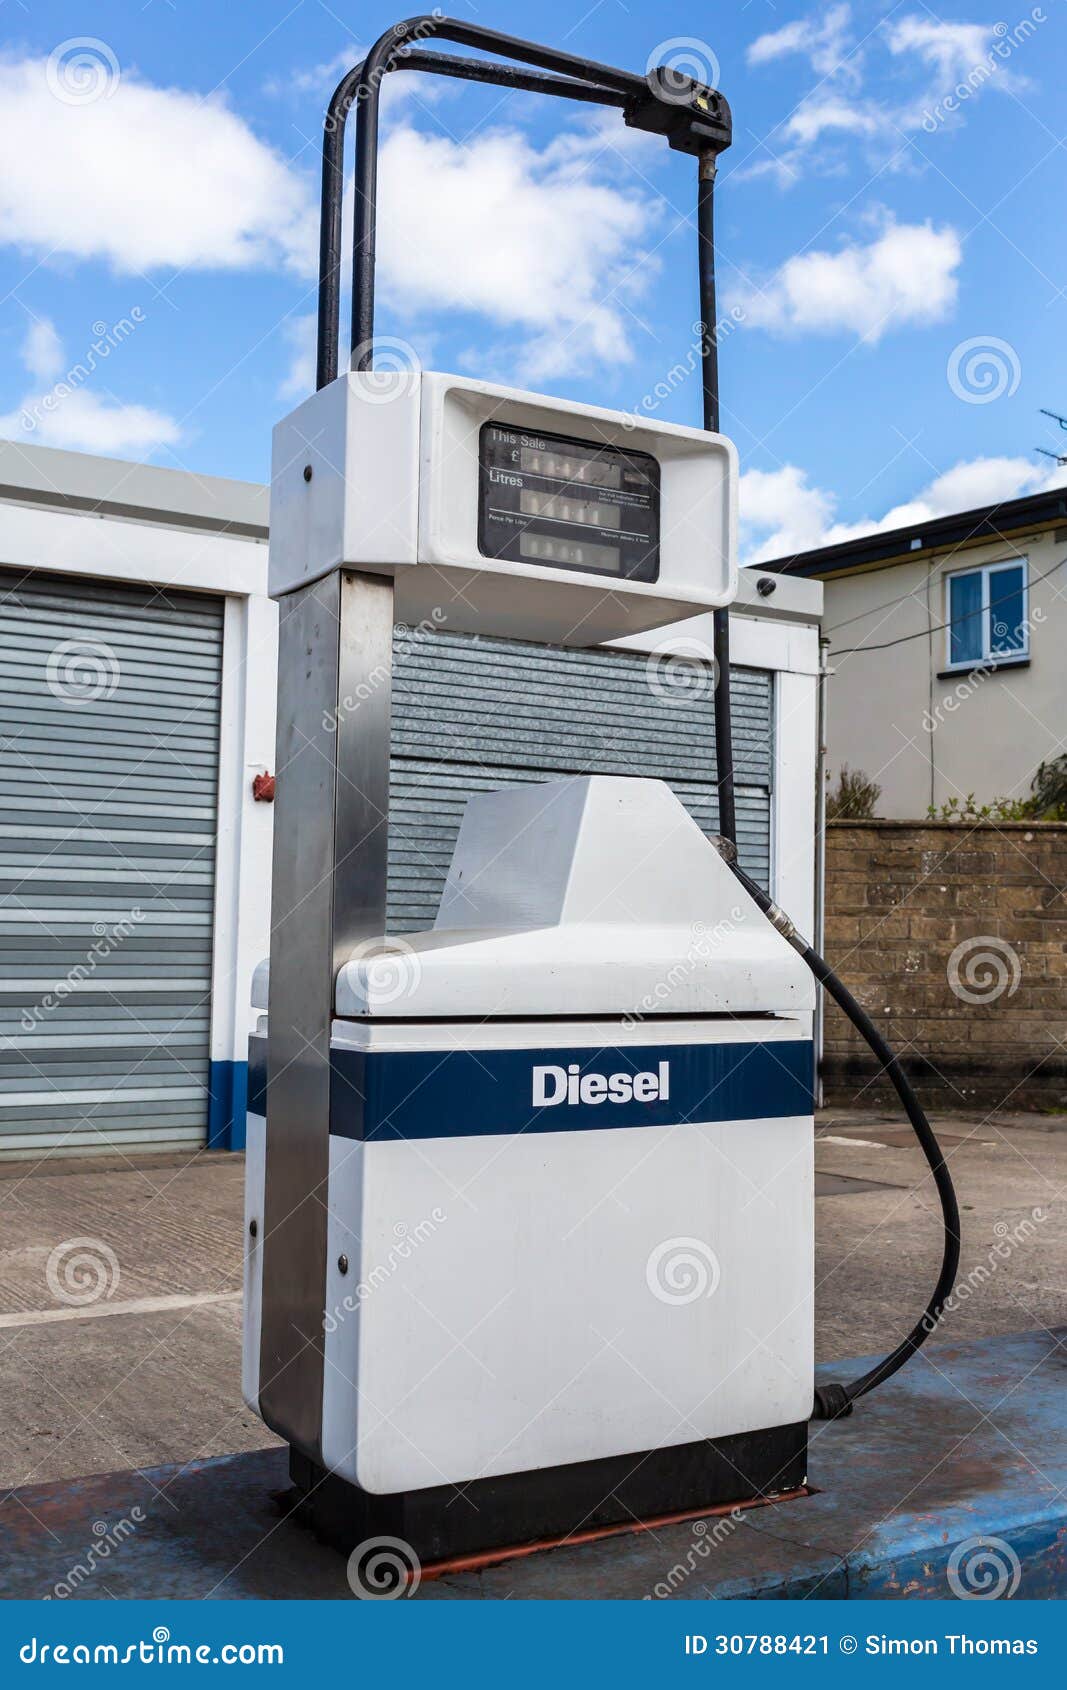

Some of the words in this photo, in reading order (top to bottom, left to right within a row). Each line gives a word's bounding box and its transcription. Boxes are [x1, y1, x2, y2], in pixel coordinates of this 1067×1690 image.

[492, 429, 517, 445] This
[520, 435, 546, 450] Sale
[489, 470, 524, 488] Litres
[532, 1061, 670, 1107] Diesel
